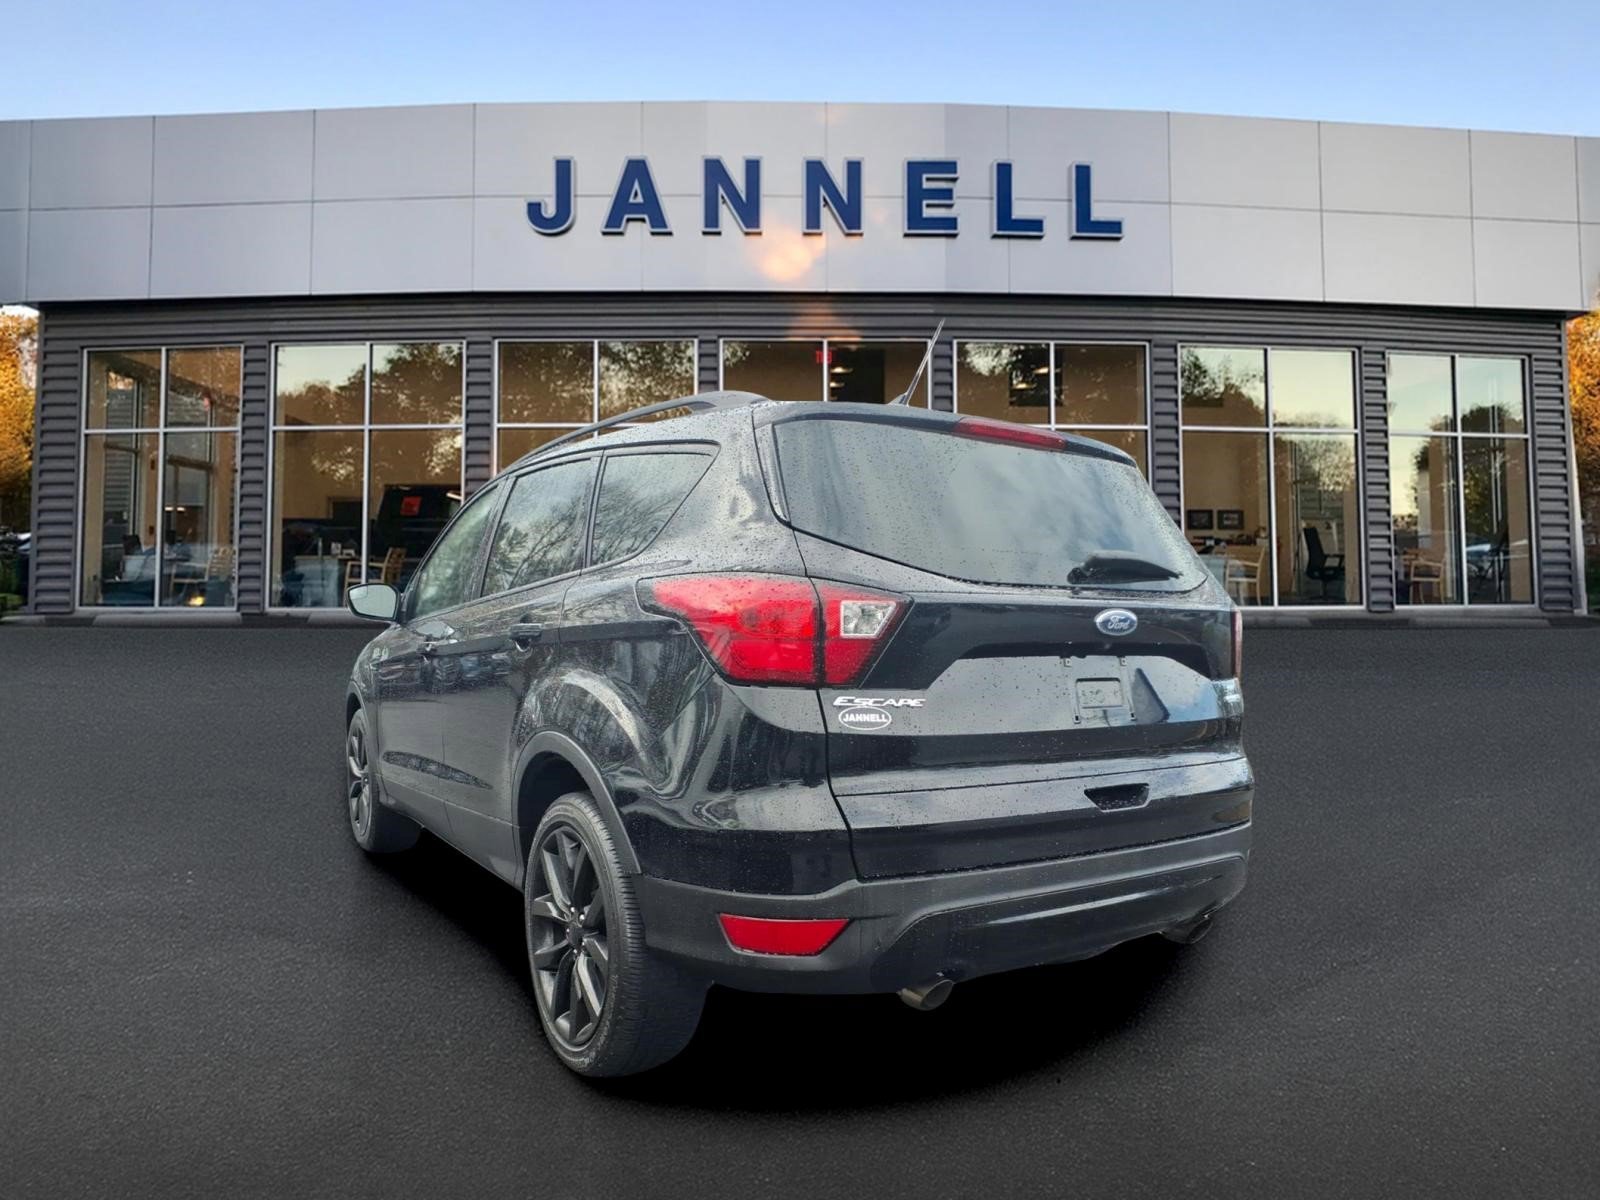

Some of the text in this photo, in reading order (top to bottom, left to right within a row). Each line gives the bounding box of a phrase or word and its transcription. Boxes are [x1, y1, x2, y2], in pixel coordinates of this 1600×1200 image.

[525, 156, 1123, 239] JANNELL
[1107, 615, 1130, 630] Ford
[833, 696, 926, 707] ESCAPE
[843, 713, 888, 722] JANNELL
